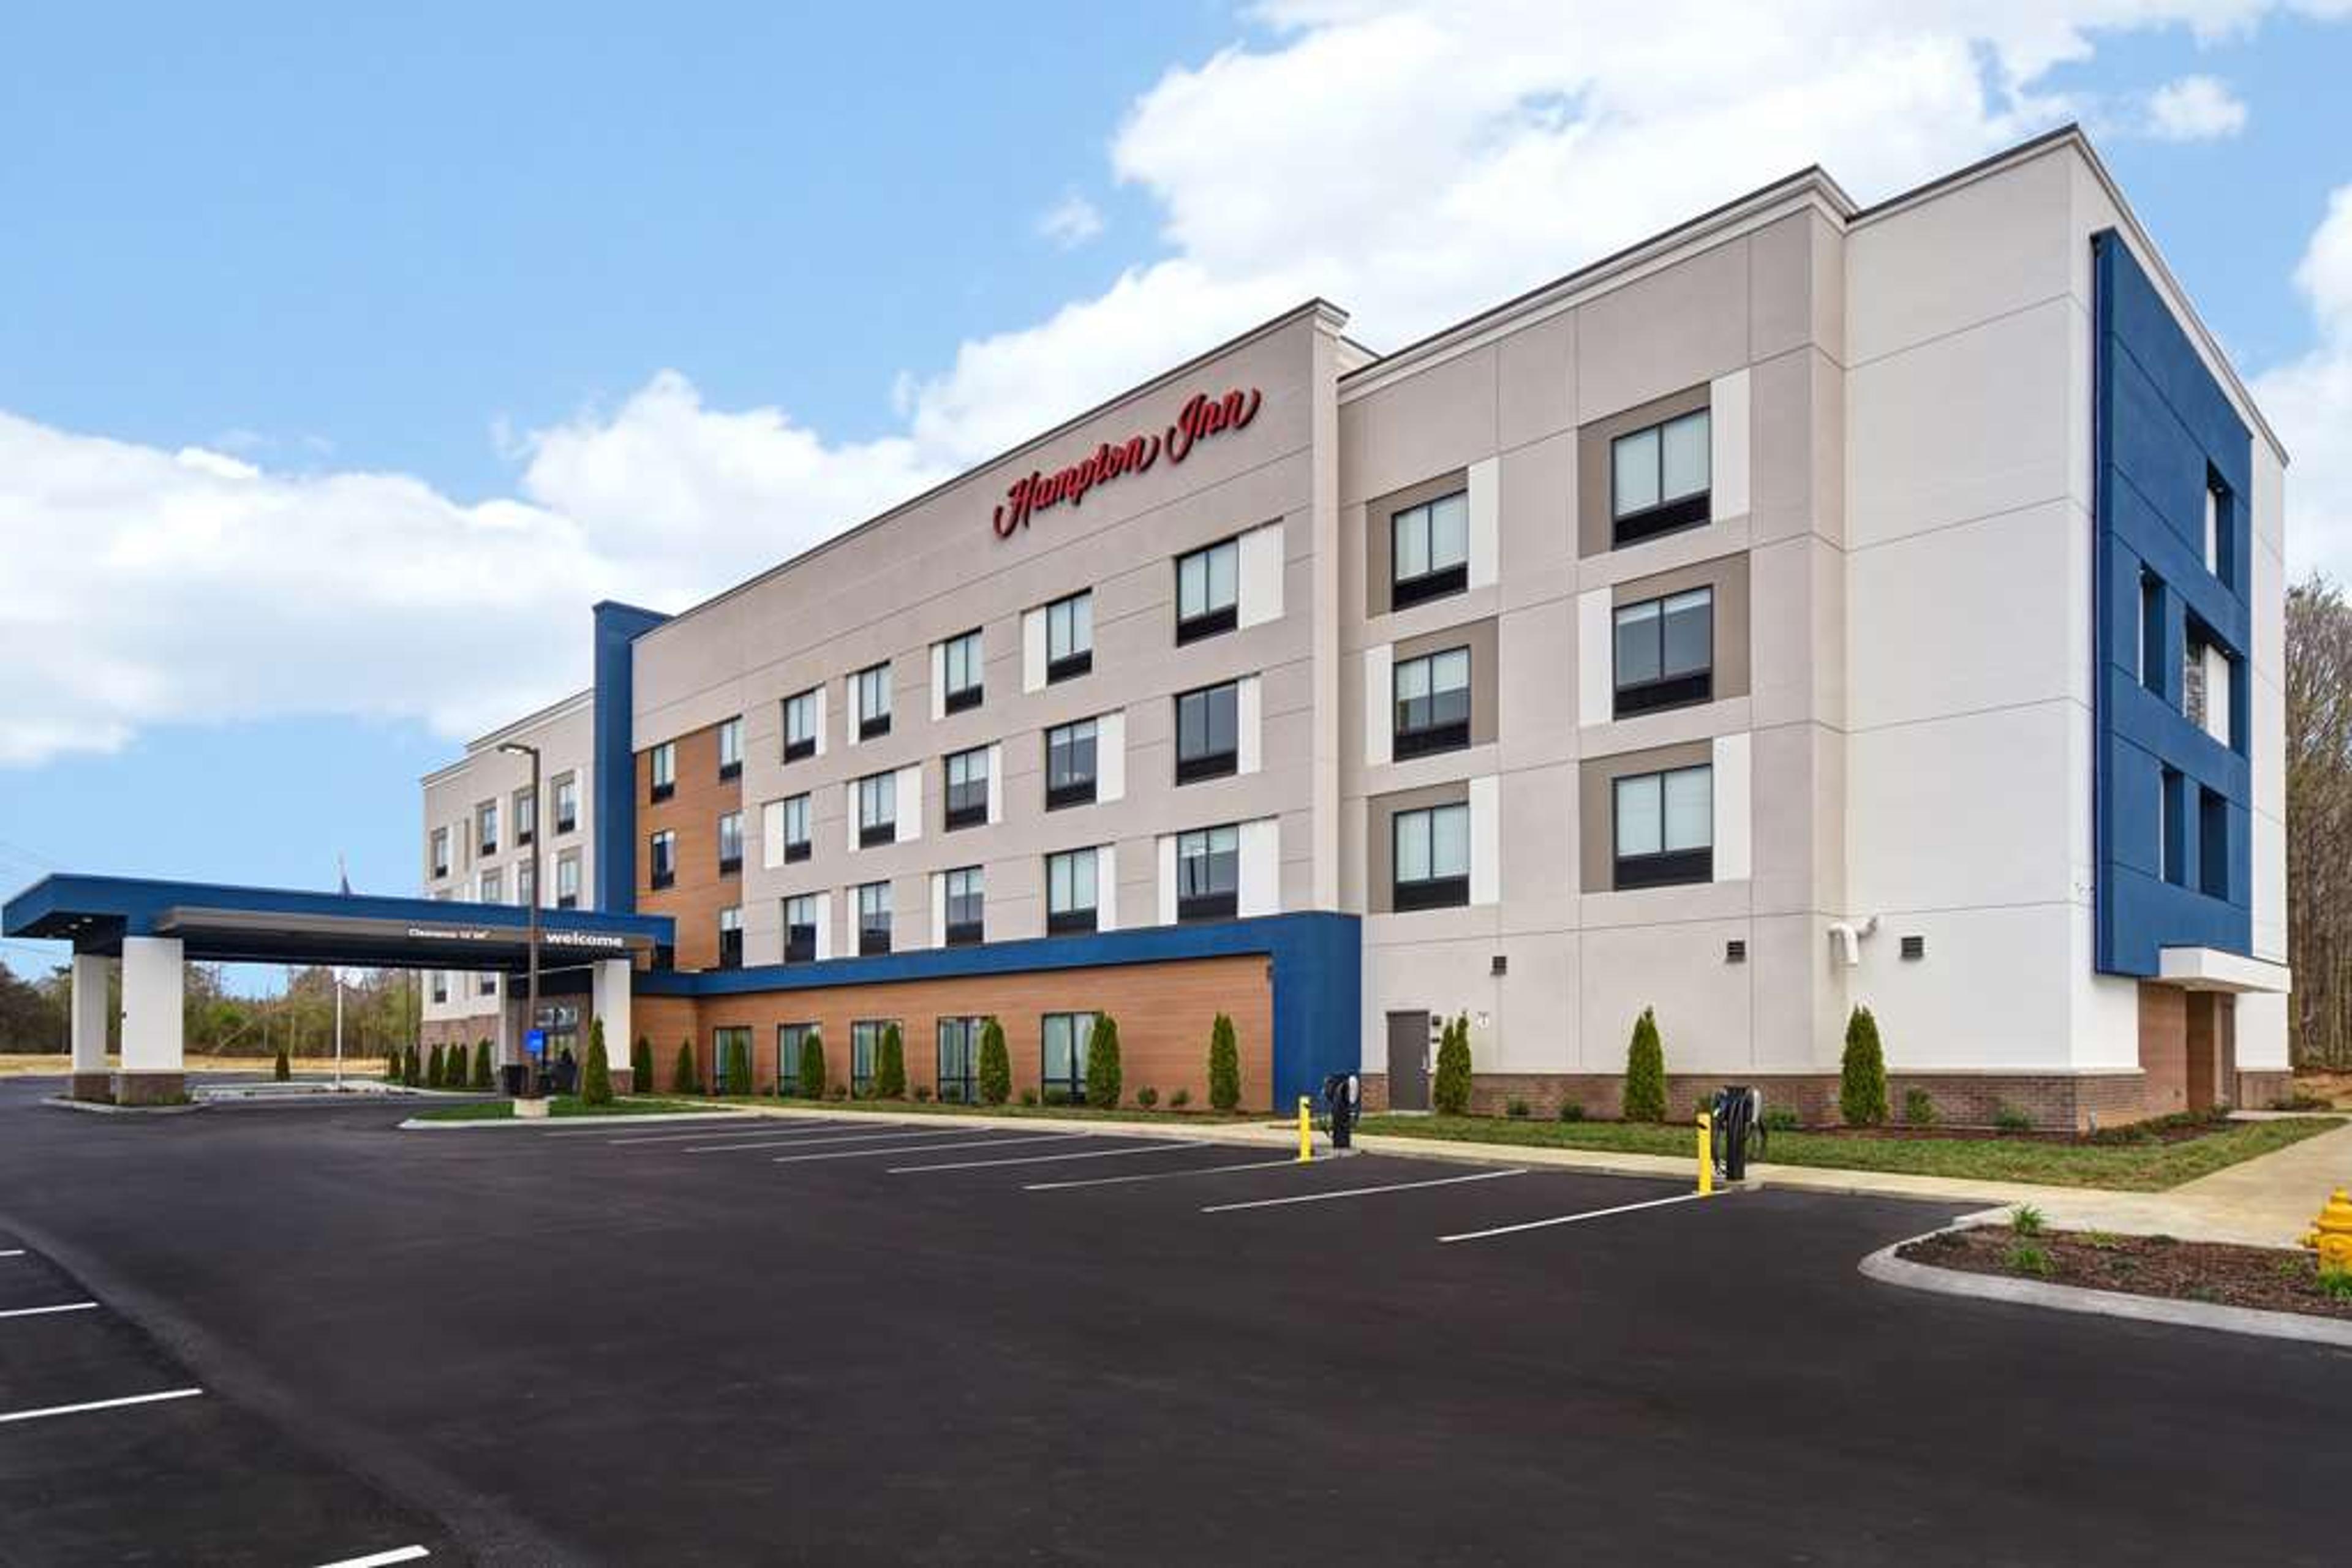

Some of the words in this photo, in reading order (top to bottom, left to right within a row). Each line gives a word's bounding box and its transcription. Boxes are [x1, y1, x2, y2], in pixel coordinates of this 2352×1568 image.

[993, 434, 1161, 538] Hampton
[1166, 387, 1262, 464] Inn
[546, 930, 624, 948] welcome
